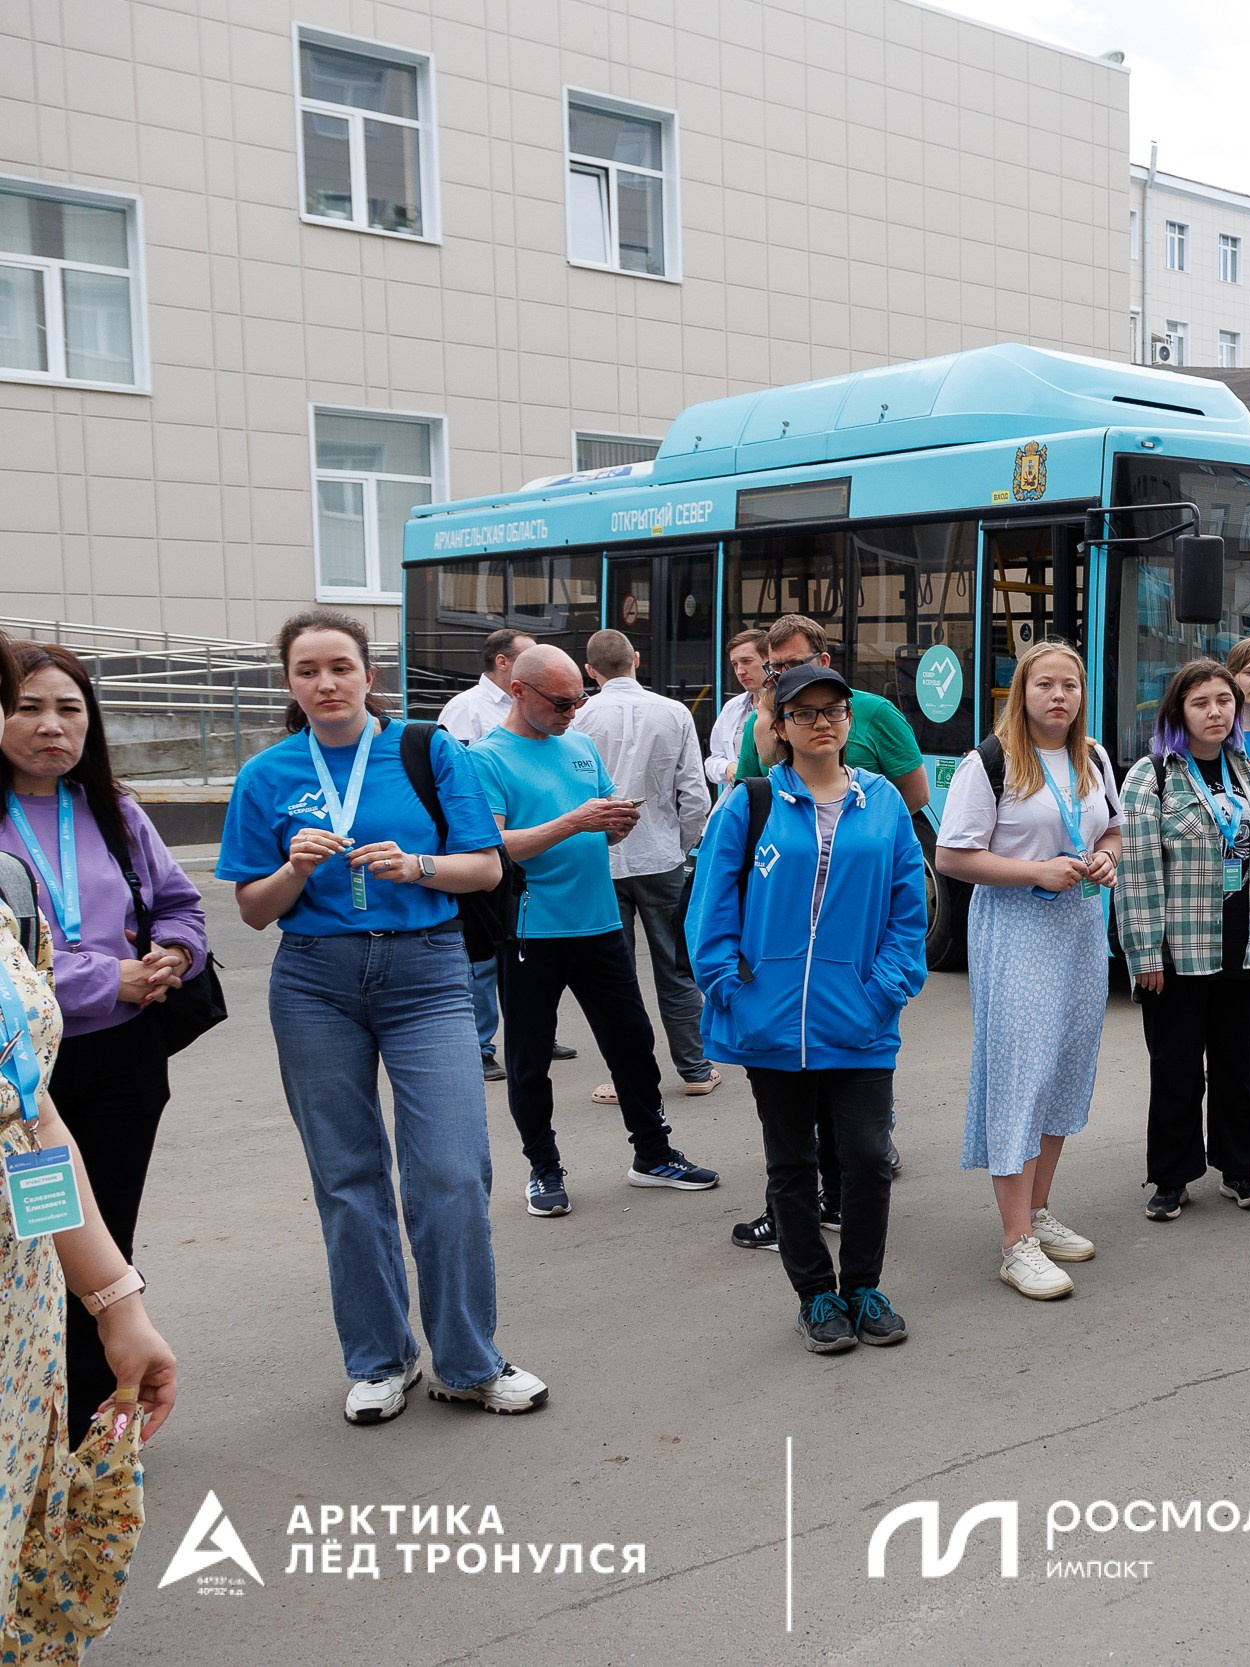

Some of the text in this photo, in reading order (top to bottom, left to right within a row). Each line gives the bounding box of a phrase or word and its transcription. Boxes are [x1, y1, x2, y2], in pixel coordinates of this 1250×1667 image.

[611, 500, 713, 532] ОТКРЫТЫЙ СЕВЕР
[434, 518, 549, 550] АРХАНГЕЛЬСКАЯ ОБЛАСТЬ
[24, 1190, 66, 1204] Селезнева
[25, 1199, 67, 1213] Елизавета
